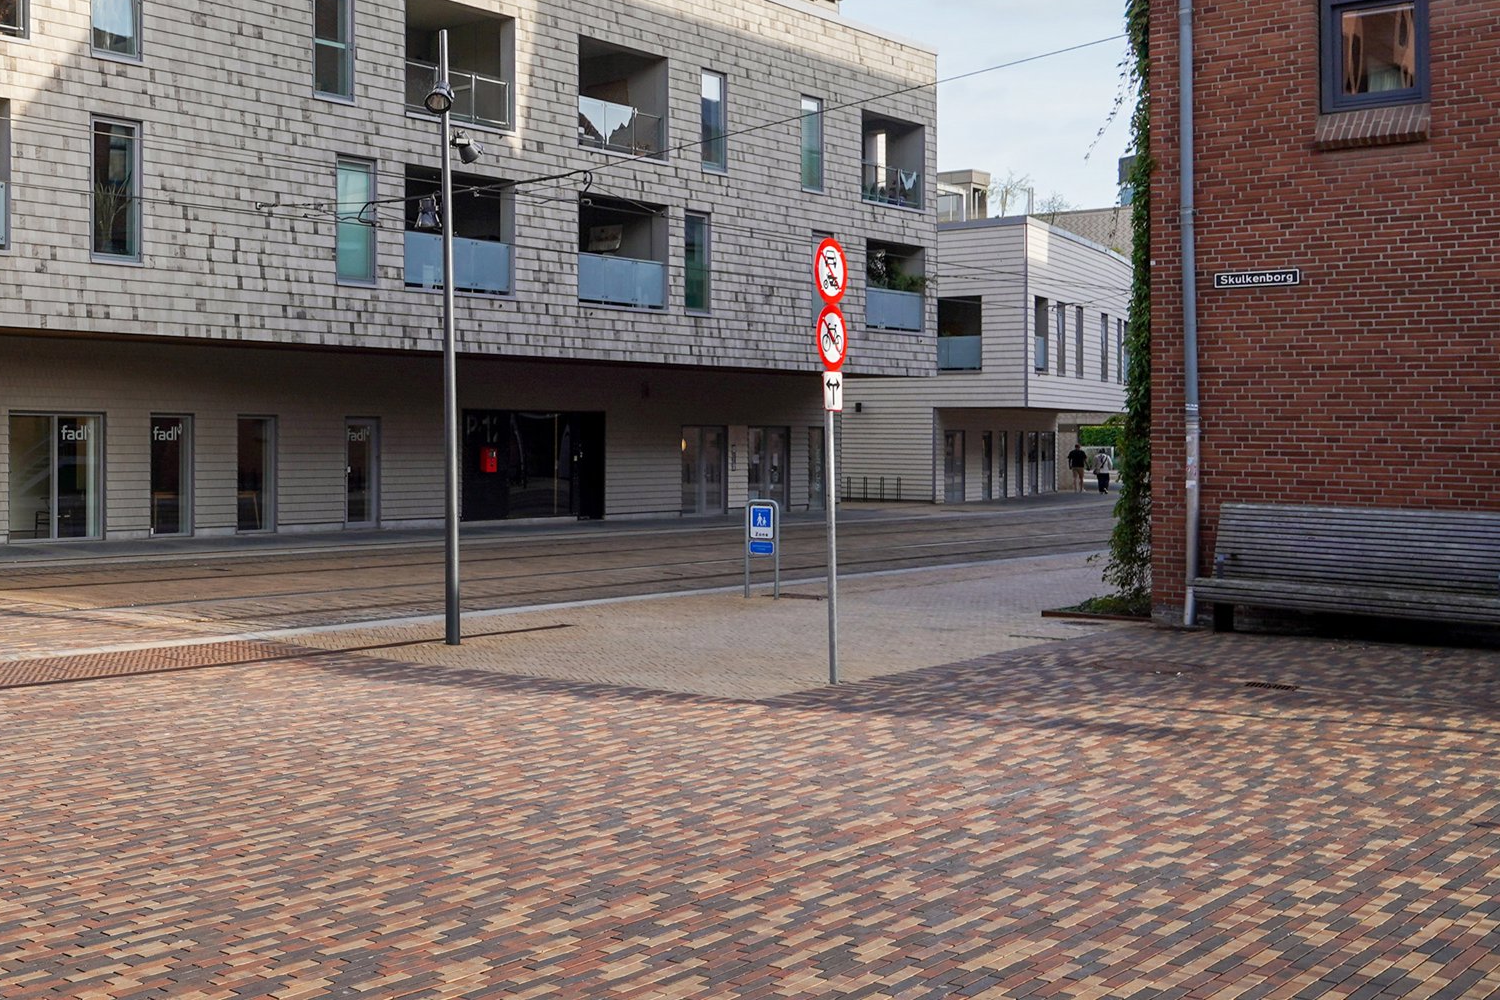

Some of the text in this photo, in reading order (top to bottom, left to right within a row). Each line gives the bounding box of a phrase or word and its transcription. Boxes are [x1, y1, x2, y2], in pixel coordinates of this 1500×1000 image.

[1220, 273, 1293, 285] Skulkenborg
[61, 425, 87, 440] fadl
[153, 426, 177, 441] fadl
